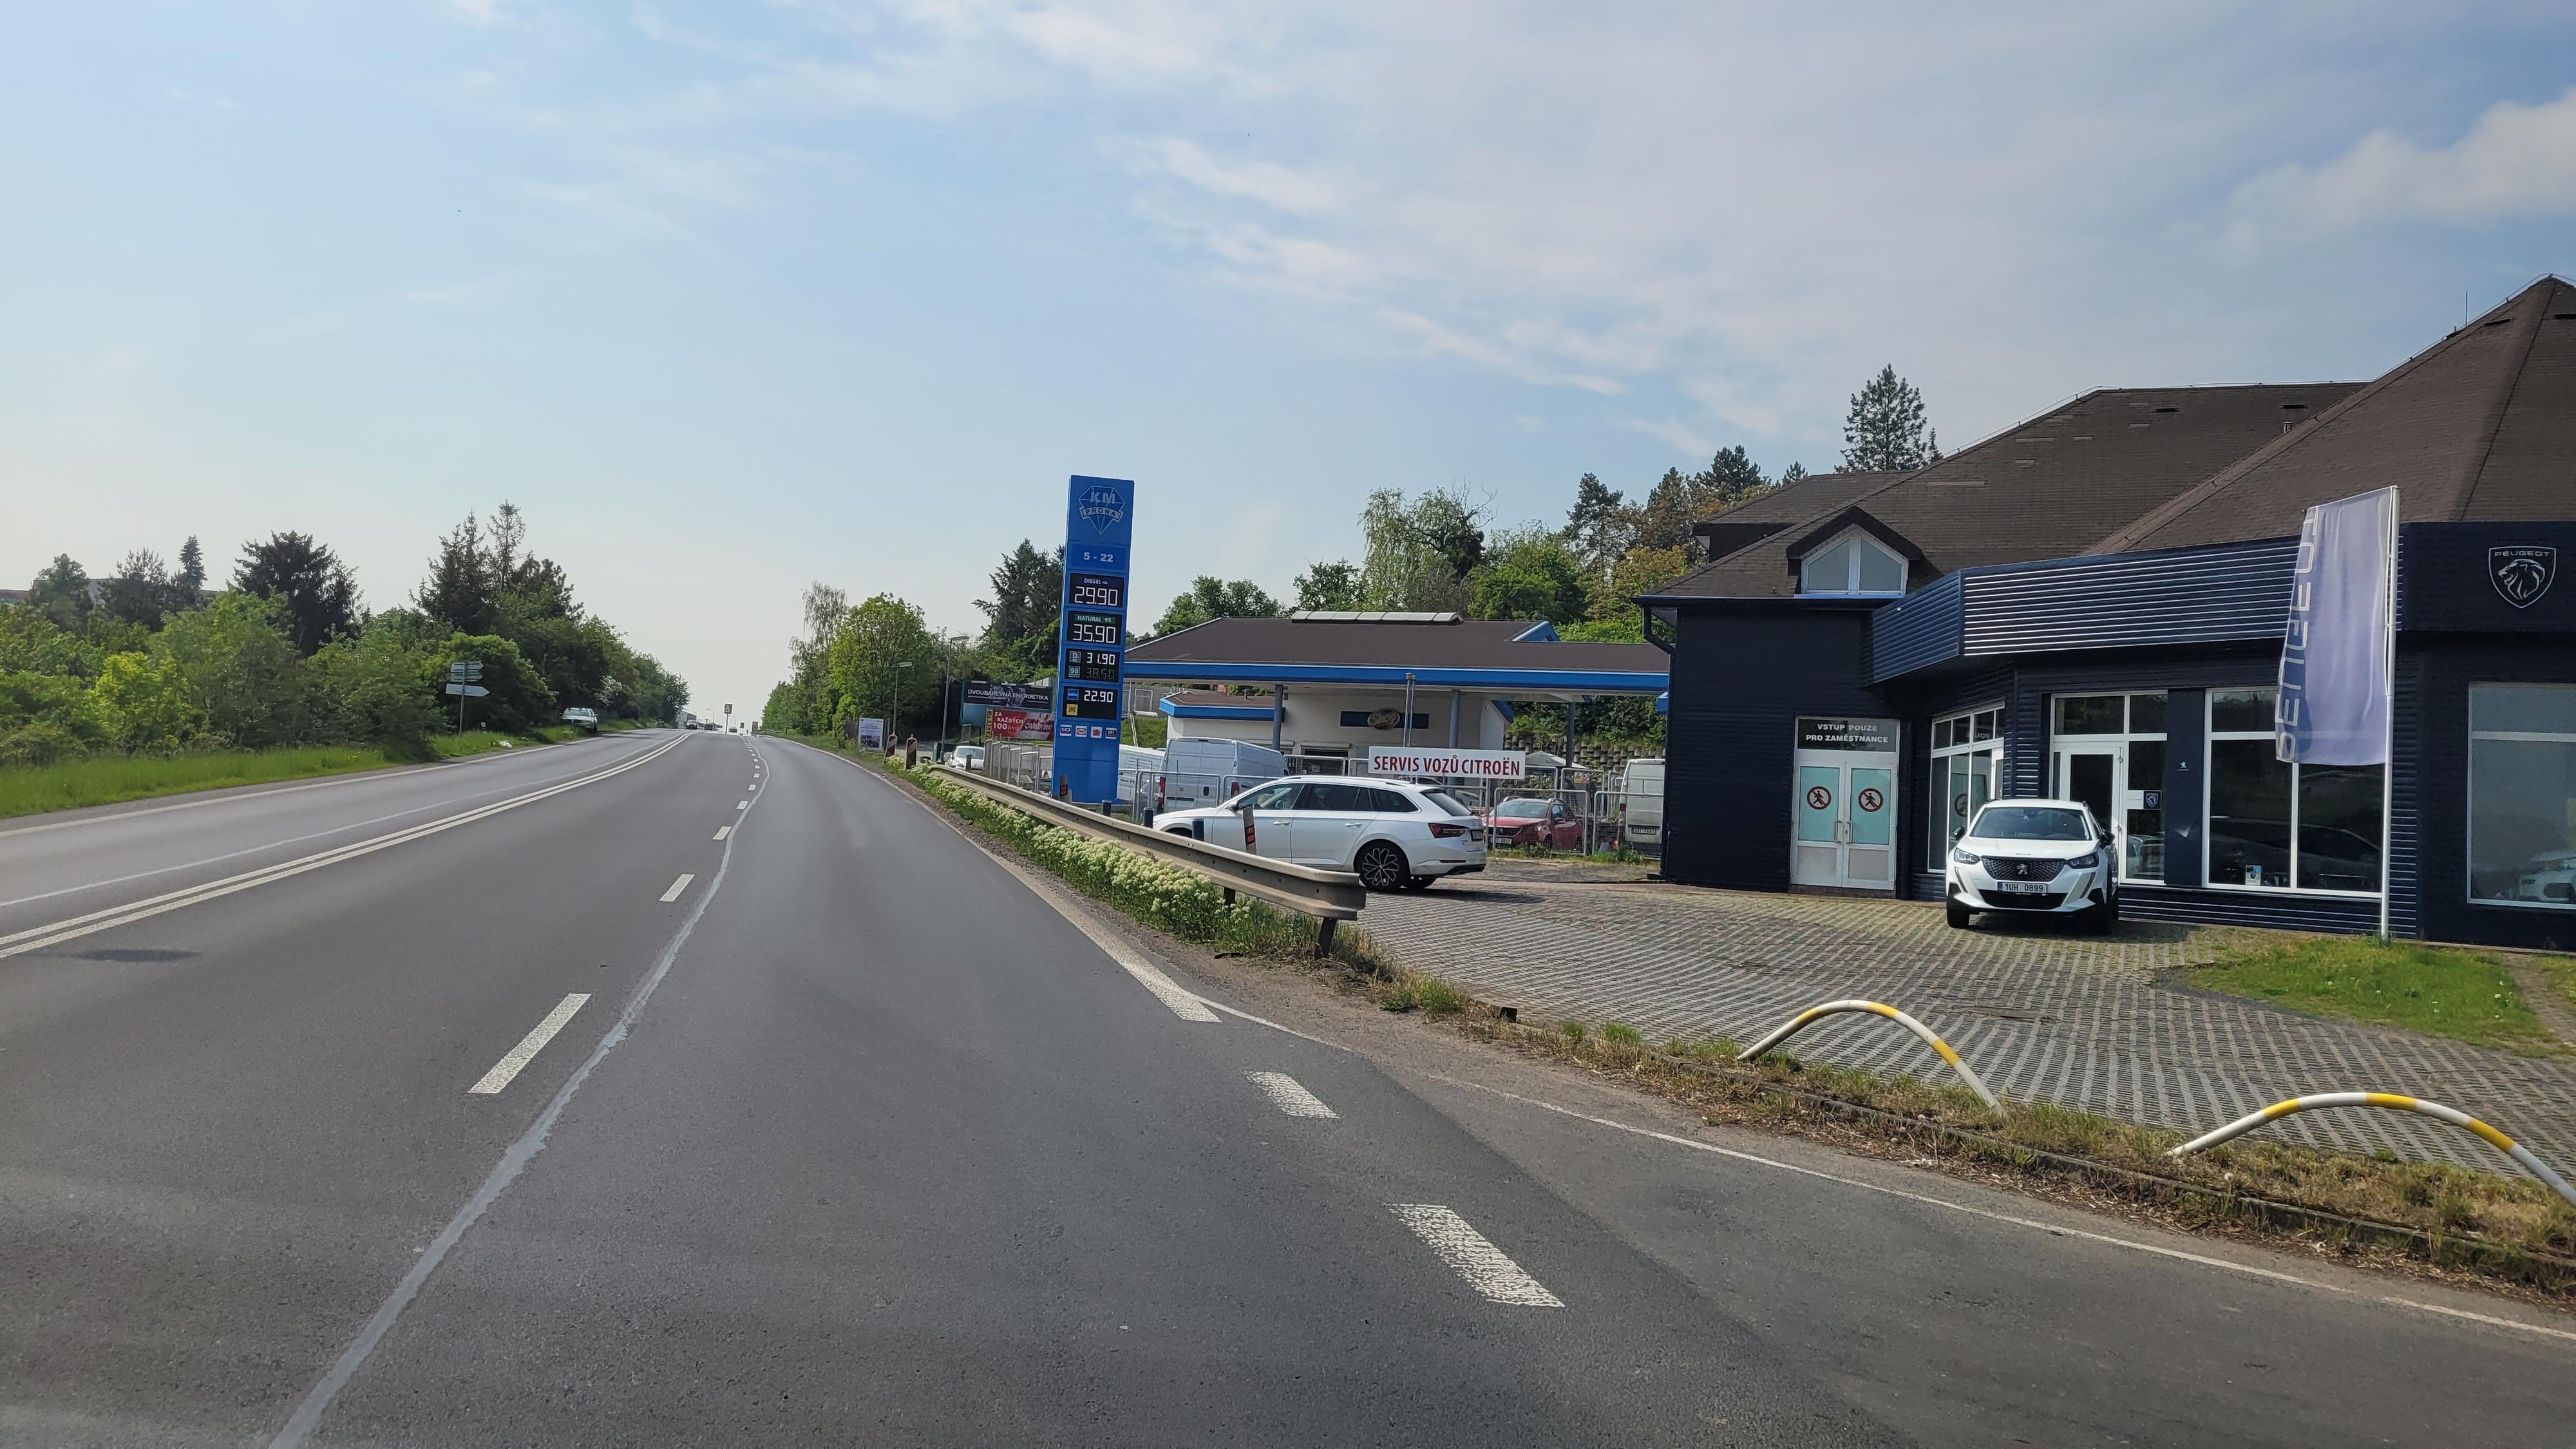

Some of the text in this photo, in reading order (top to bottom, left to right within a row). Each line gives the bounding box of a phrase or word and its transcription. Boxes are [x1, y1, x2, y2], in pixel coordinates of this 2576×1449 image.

[1090, 491, 1115, 504] KM
[1085, 507, 1115, 516] PRONA
[1083, 552, 1090, 560] 5
[1100, 553, 1113, 562] 22
[1074, 586, 1118, 606] 29.90
[1072, 623, 1116, 644] 35.90
[1086, 652, 1115, 665] 31.90
[1012, 692, 1049, 701] ENERGETIKA
[1083, 690, 1113, 703] 22.90
[1825, 734, 1889, 743] ZAMĚSTNANCE
[1374, 754, 1520, 776] SERVIS VOZŮ CITROËN
[2004, 883, 2043, 892] 1UH 0899
